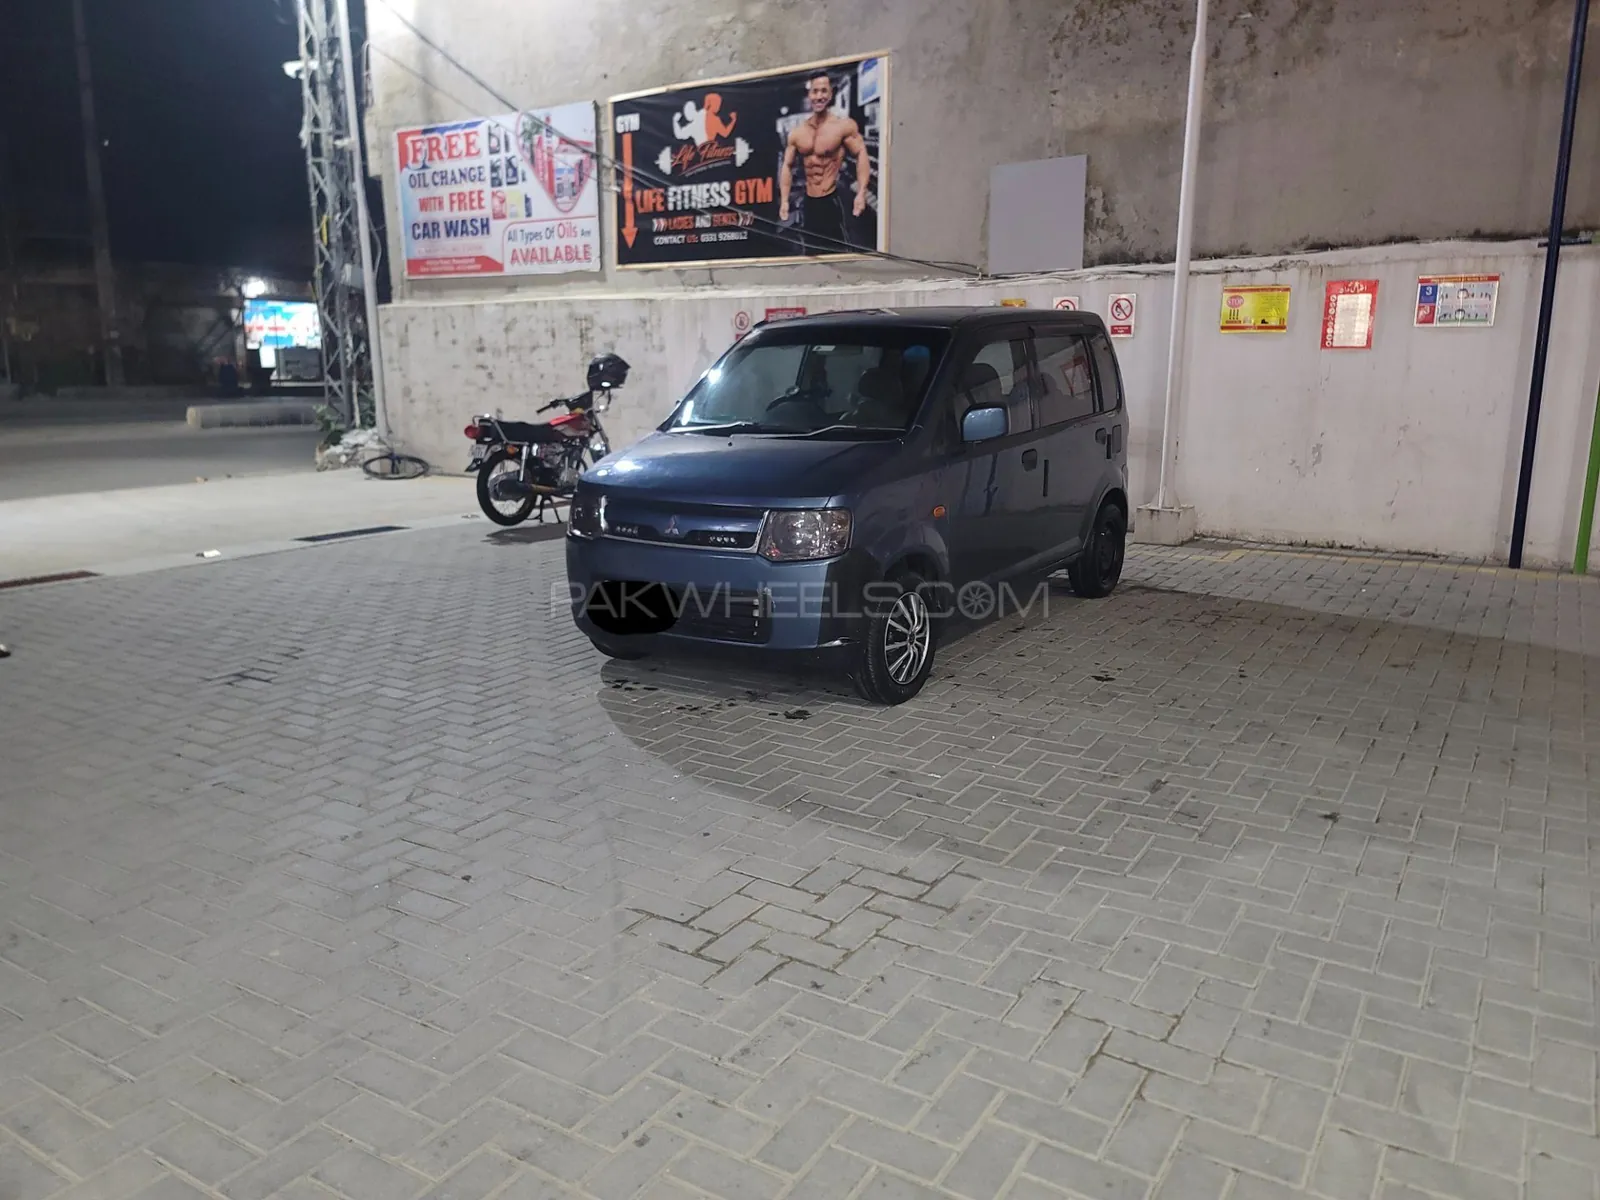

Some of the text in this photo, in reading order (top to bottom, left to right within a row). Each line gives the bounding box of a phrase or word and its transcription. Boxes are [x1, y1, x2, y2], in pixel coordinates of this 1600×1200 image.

[616, 113, 640, 133] GYM
[410, 131, 481, 165] FREE
[408, 165, 486, 189] OIL CHANGE
[419, 190, 485, 213] WITH FREE
[635, 177, 773, 213] LIFE FITNESS GYM
[412, 217, 490, 240] CAR WASH
[508, 229, 517, 242] All
[520, 229, 542, 245] Types
[557, 222, 578, 239] Oils
[653, 235, 685, 245] CONTACT
[510, 244, 592, 265] AVAILABLE
